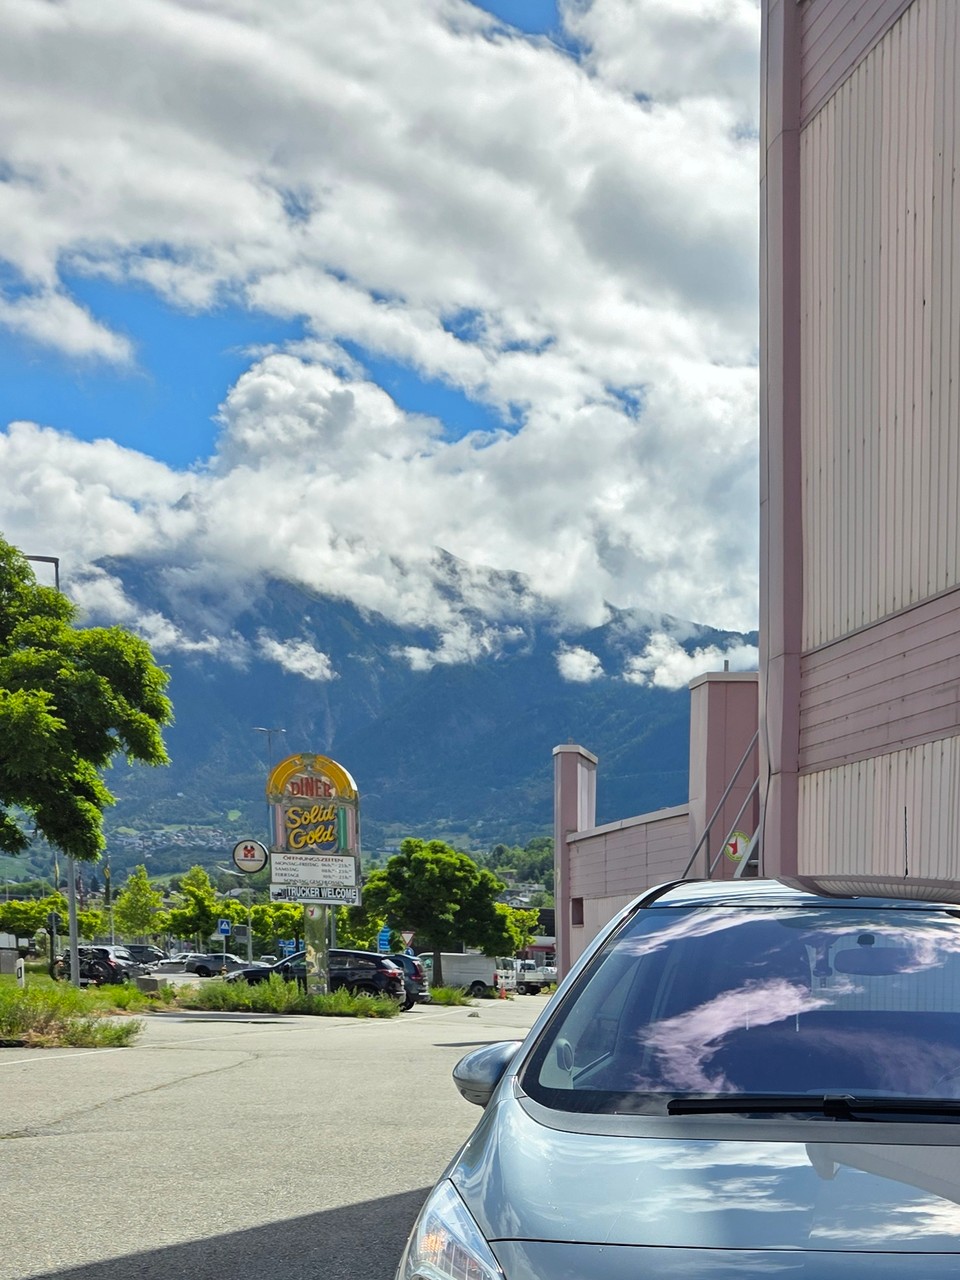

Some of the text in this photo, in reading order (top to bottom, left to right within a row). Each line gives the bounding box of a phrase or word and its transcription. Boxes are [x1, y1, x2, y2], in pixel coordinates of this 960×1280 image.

[286, 804, 336, 828] Solid
[289, 825, 335, 848] Gold
[287, 886, 356, 899] TRUCKER WELCOME
